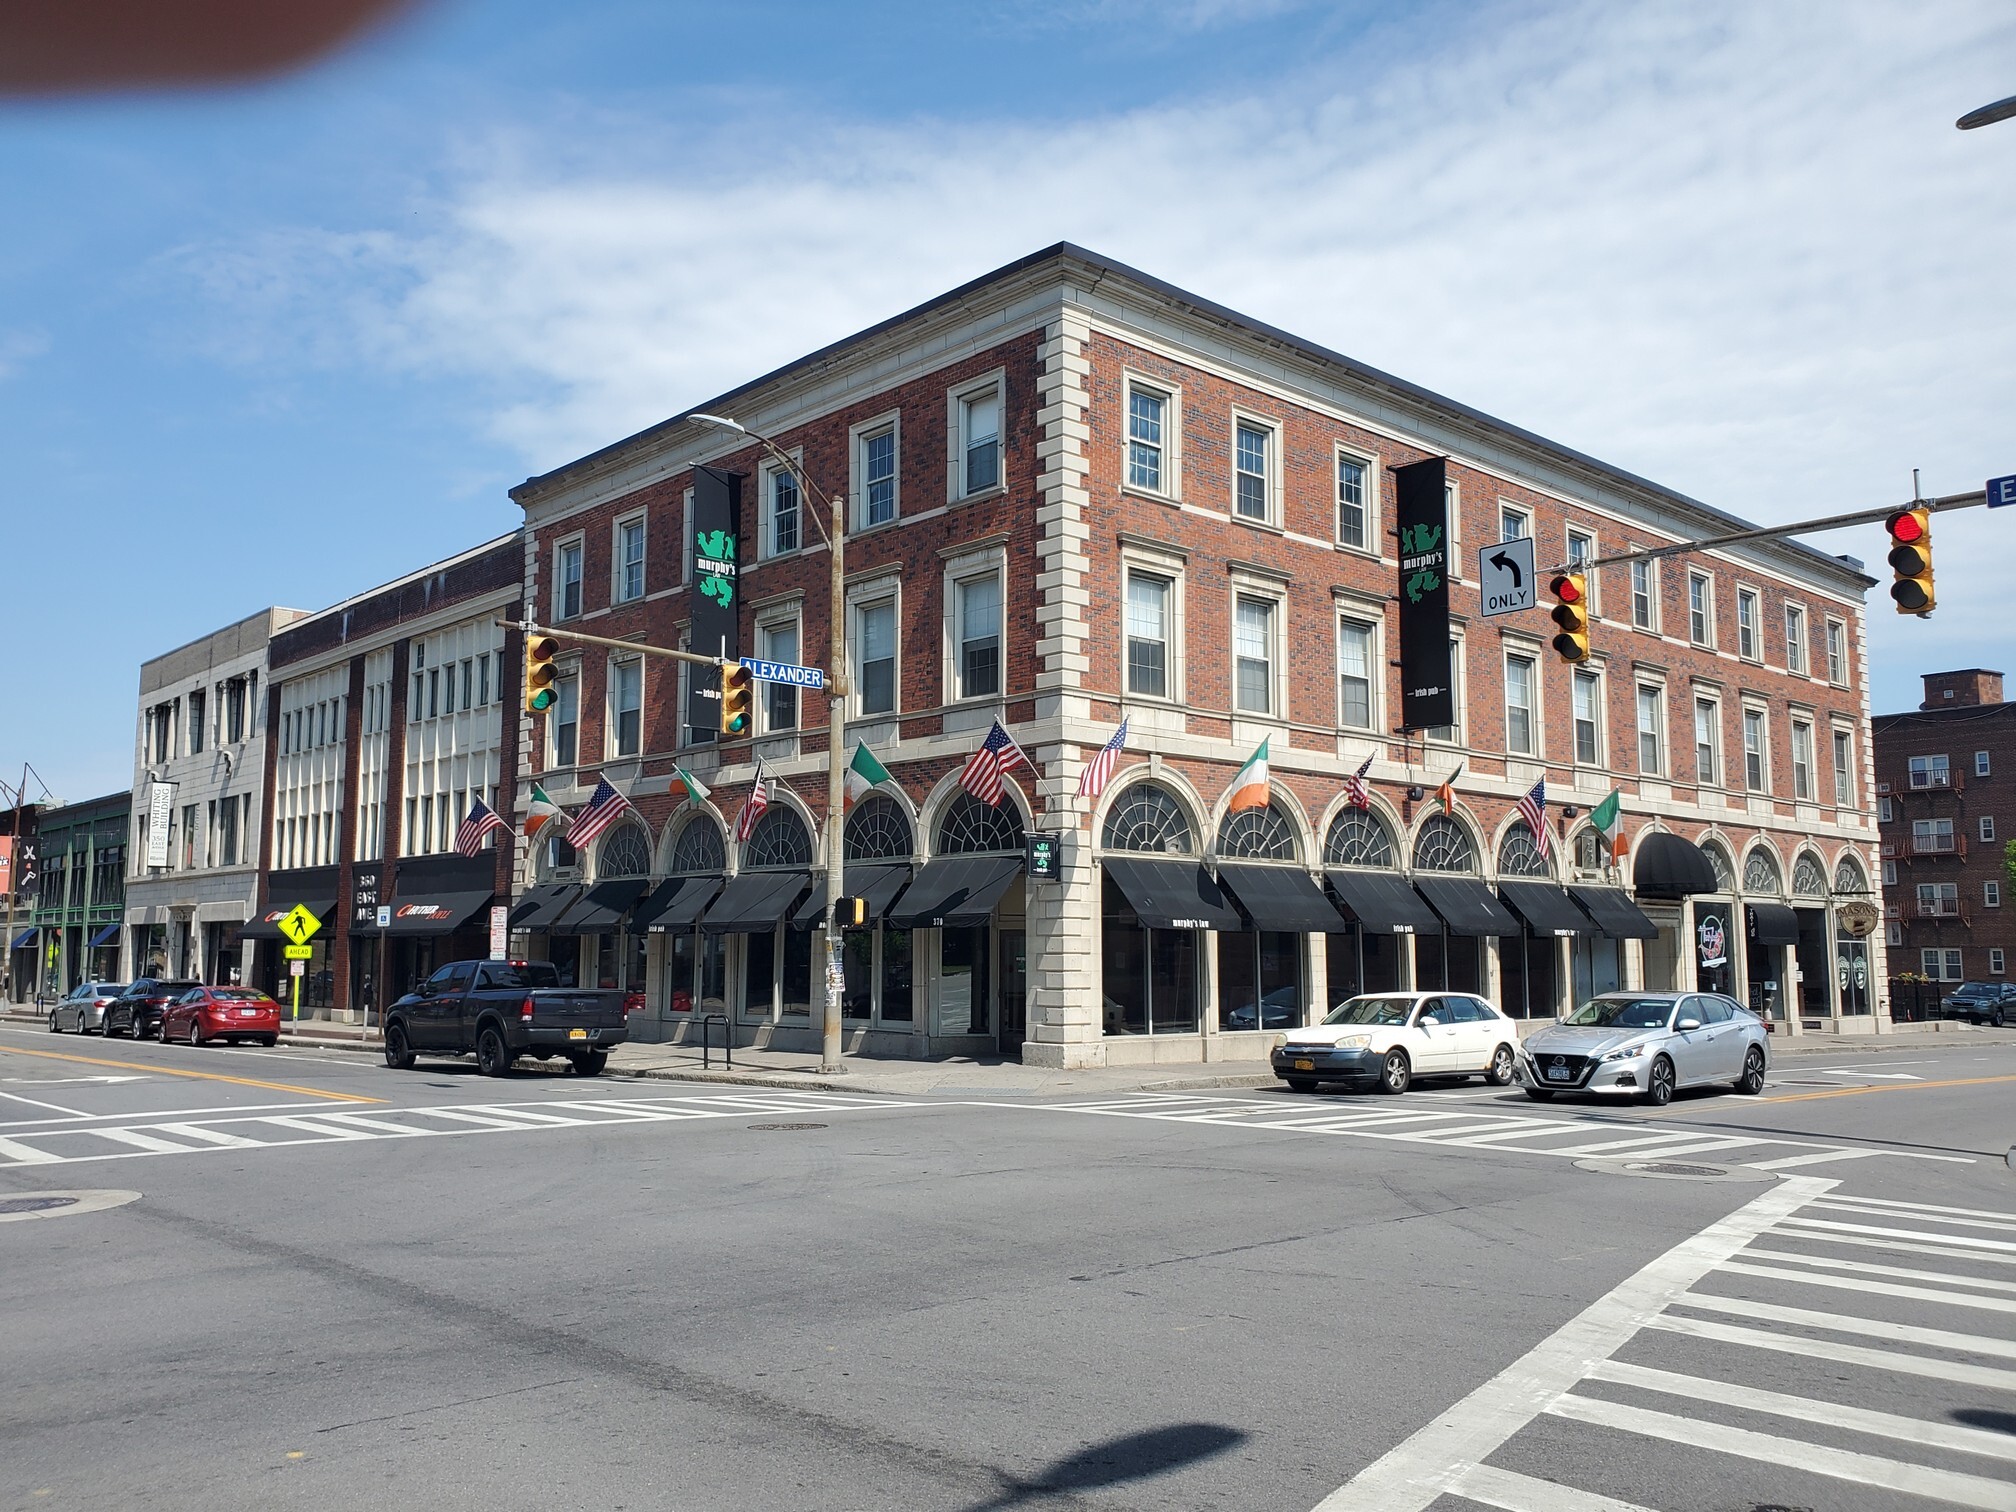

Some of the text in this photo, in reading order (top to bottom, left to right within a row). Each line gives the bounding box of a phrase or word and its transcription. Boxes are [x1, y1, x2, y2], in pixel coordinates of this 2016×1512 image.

[697, 558, 736, 576] murphy's
[1403, 551, 1443, 570] murphy's
[1488, 590, 1528, 610] ONLY
[743, 660, 822, 686] ALEXANDER
[151, 788, 162, 828] WHITING
[159, 787, 170, 830] BUILDING
[359, 874, 376, 887] 360
[356, 891, 377, 904] EAST
[356, 907, 375, 921] AVE.
[1839, 906, 1877, 916] MASONS
[1172, 918, 1198, 928] murphy's
[289, 948, 309, 956] AHEAD
